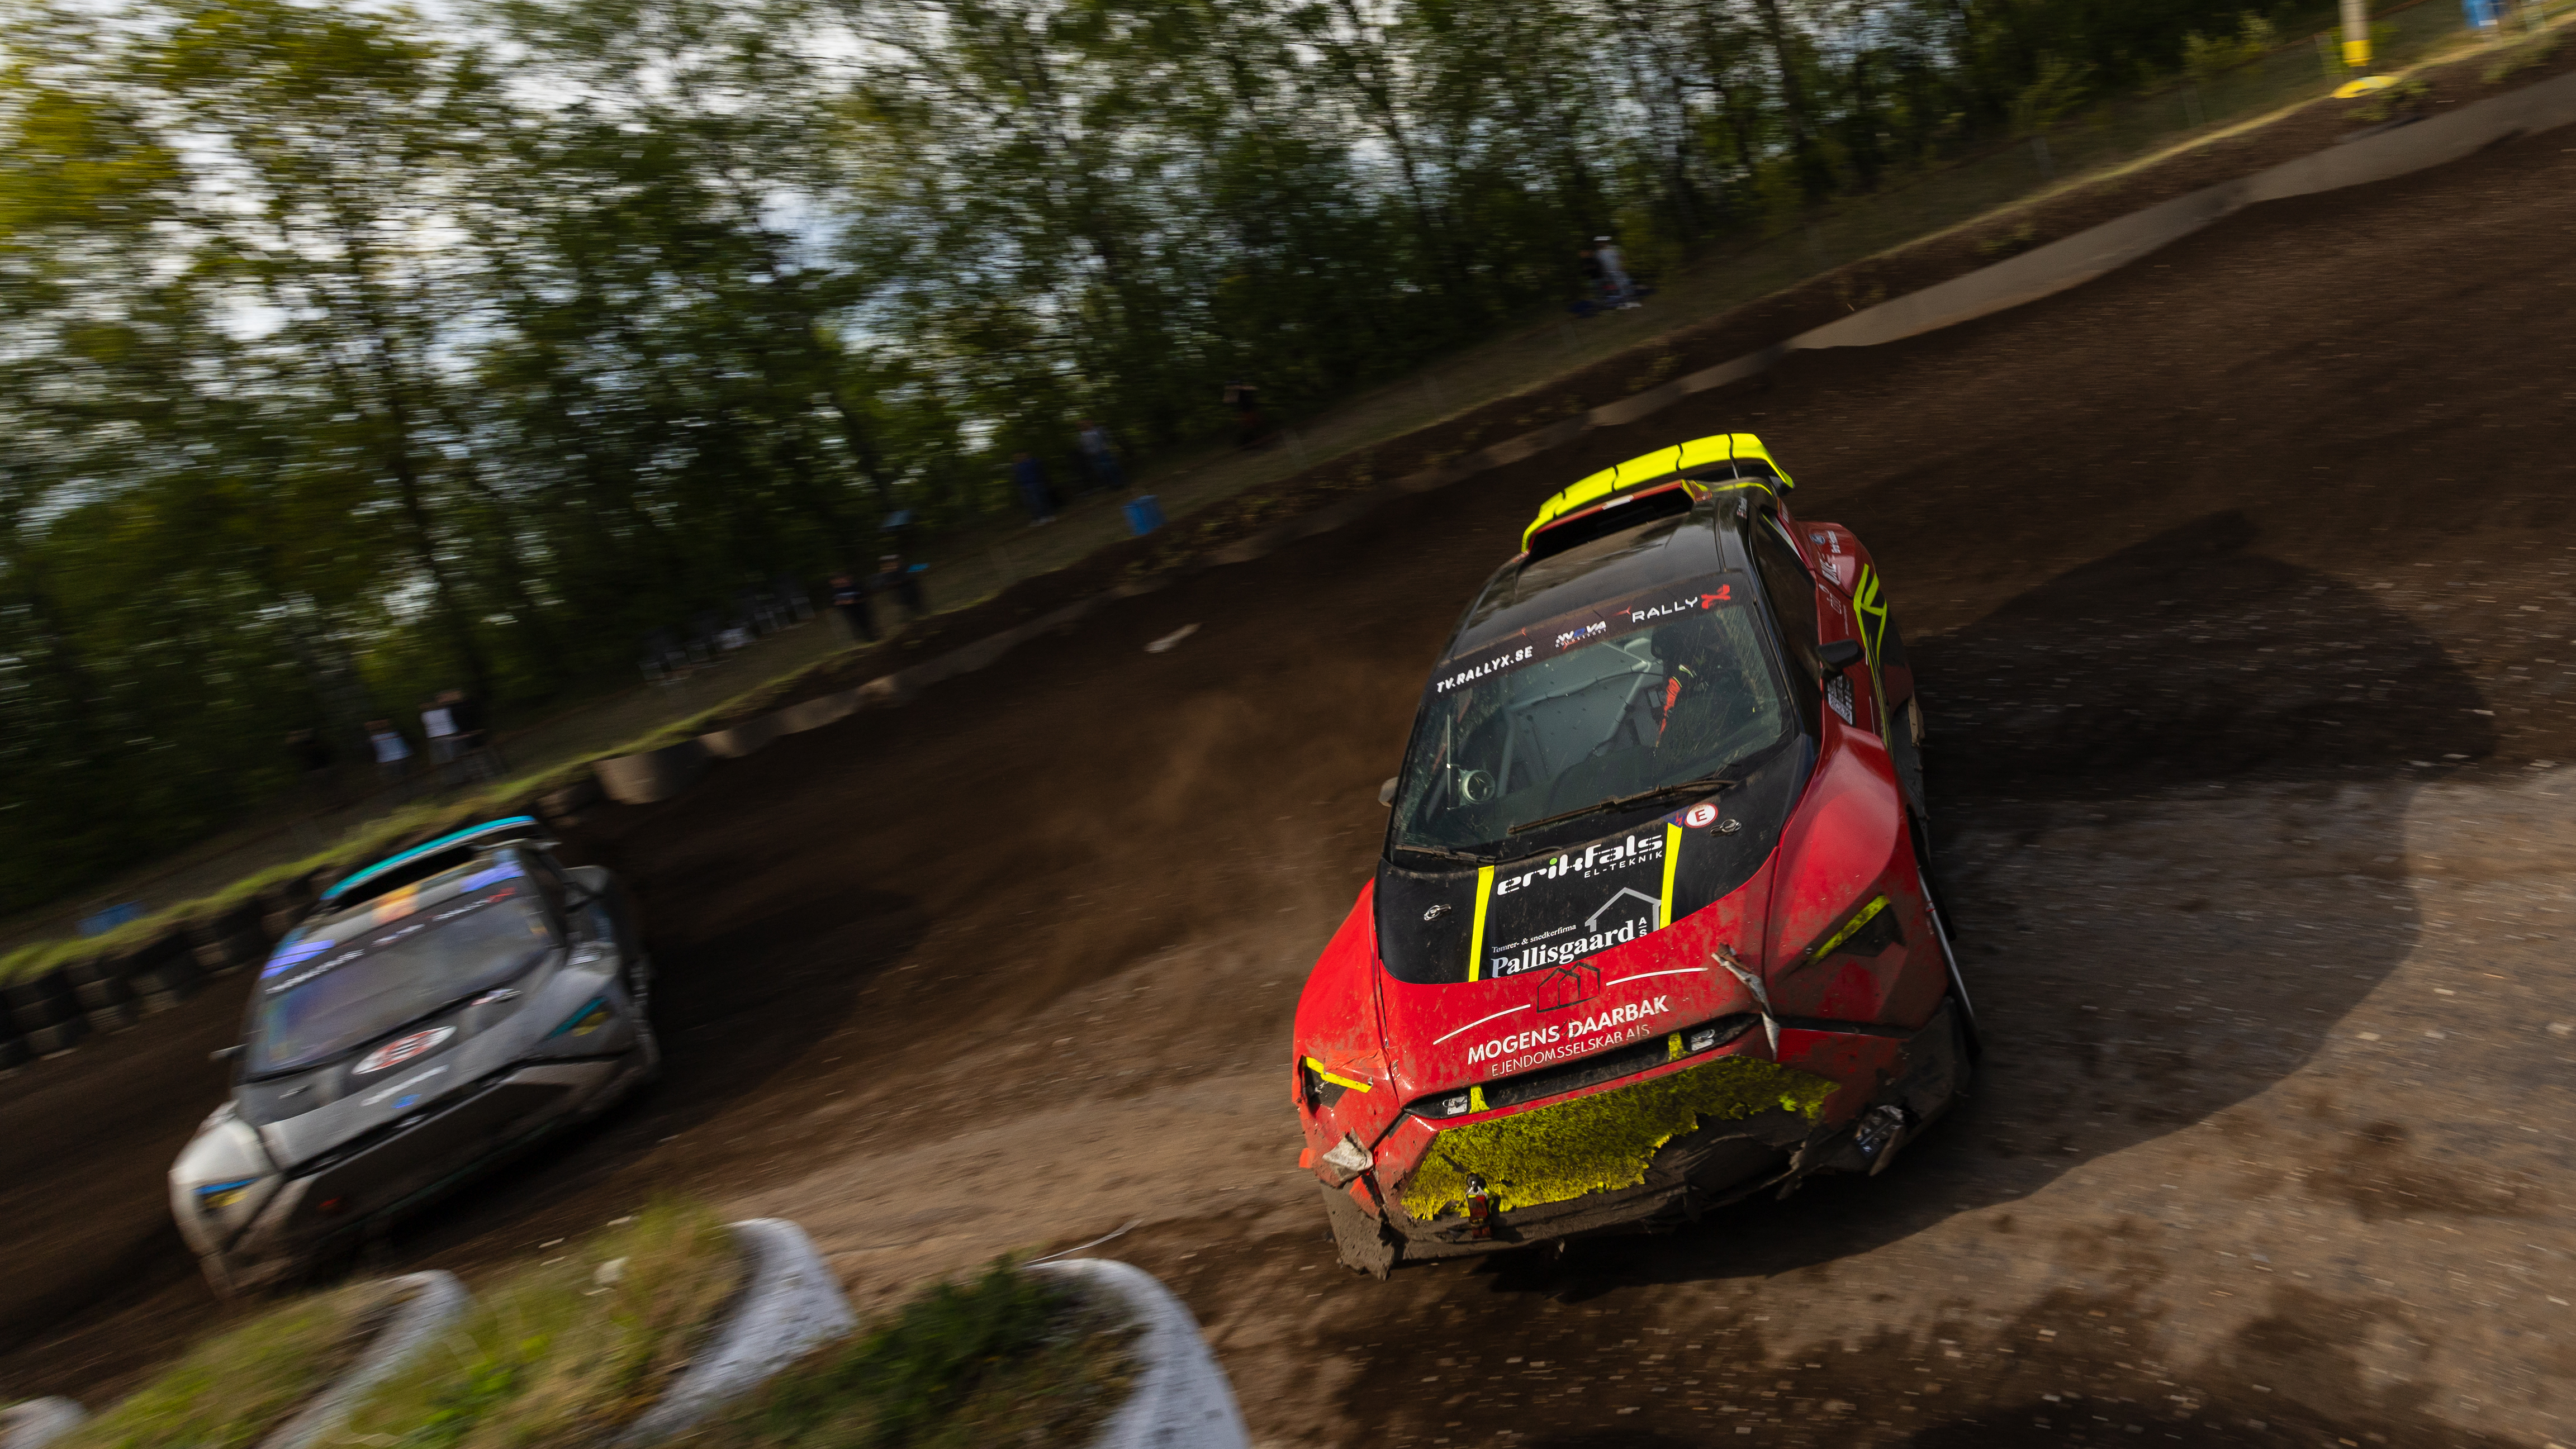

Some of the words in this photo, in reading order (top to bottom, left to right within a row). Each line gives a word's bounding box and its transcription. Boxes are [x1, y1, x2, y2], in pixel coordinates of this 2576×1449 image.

[1436, 645, 1533, 693] TV.RALLYX.SE
[1695, 809, 1707, 824] E
[1584, 850, 1663, 878] EL-TEKNIK
[1490, 919, 1636, 978] Pallisgaard
[1491, 942, 1520, 953] Tømrer-
[1530, 924, 1577, 943] snedkerfirma
[1467, 1025, 1560, 1065] MOGENS
[1568, 995, 1670, 1041] DAARBAK
[1491, 1031, 1623, 1077] EJENDOMSSELSKAB
